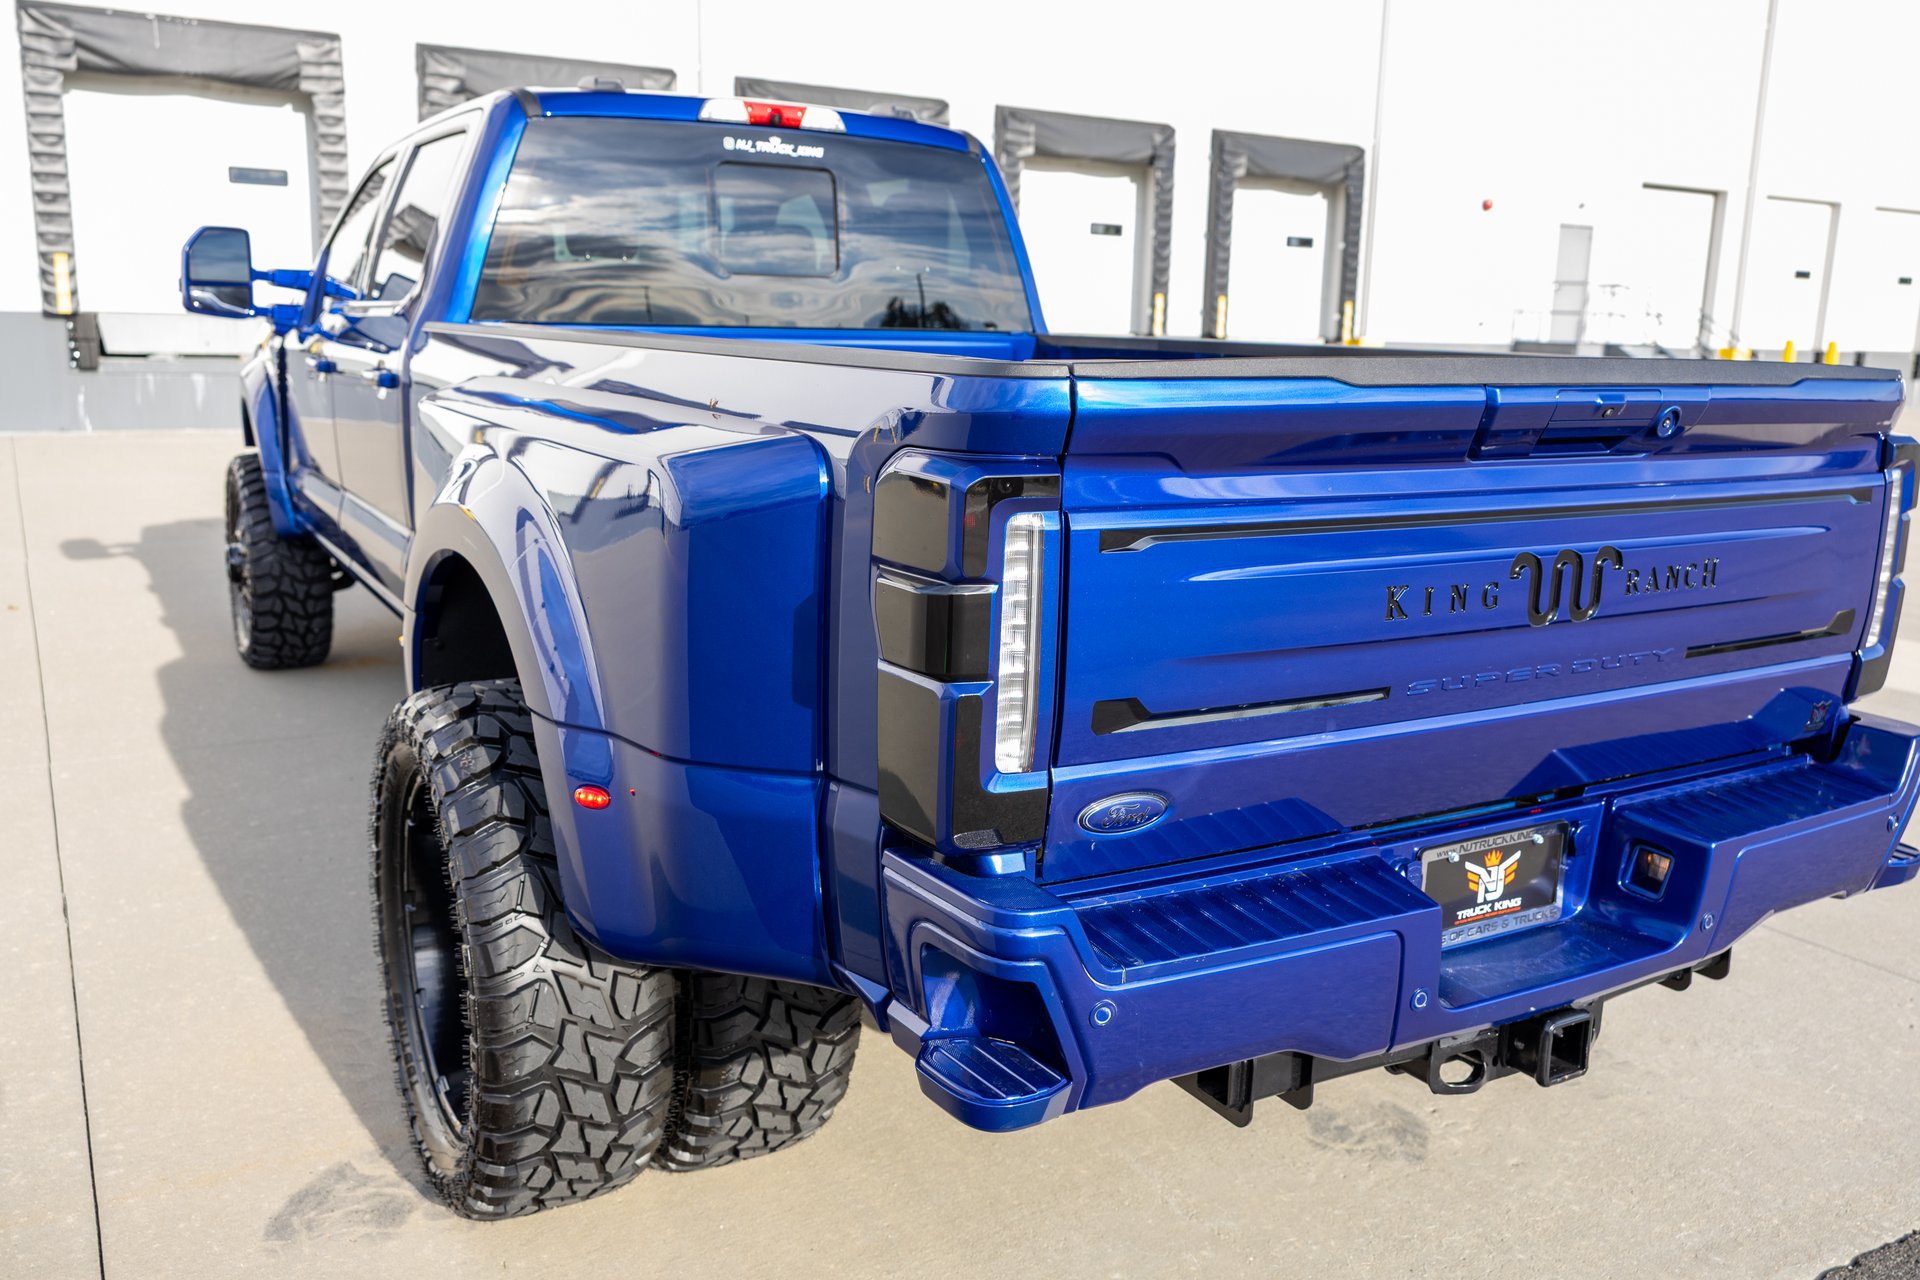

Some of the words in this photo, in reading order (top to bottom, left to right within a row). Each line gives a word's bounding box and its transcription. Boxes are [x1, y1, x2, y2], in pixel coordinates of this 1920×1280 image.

[1385, 582, 1499, 621] KING
[1625, 557, 1720, 596] RANCH
[1407, 663, 1562, 696] SUPER
[1570, 647, 1675, 675] DUTY
[1102, 803, 1151, 828] Ford
[1450, 930, 1465, 942] OF
[1467, 921, 1498, 937] CARS
[1513, 908, 1558, 926] TRUCKS
[1456, 903, 1492, 920] TRUCK
[1494, 897, 1522, 911] KING
